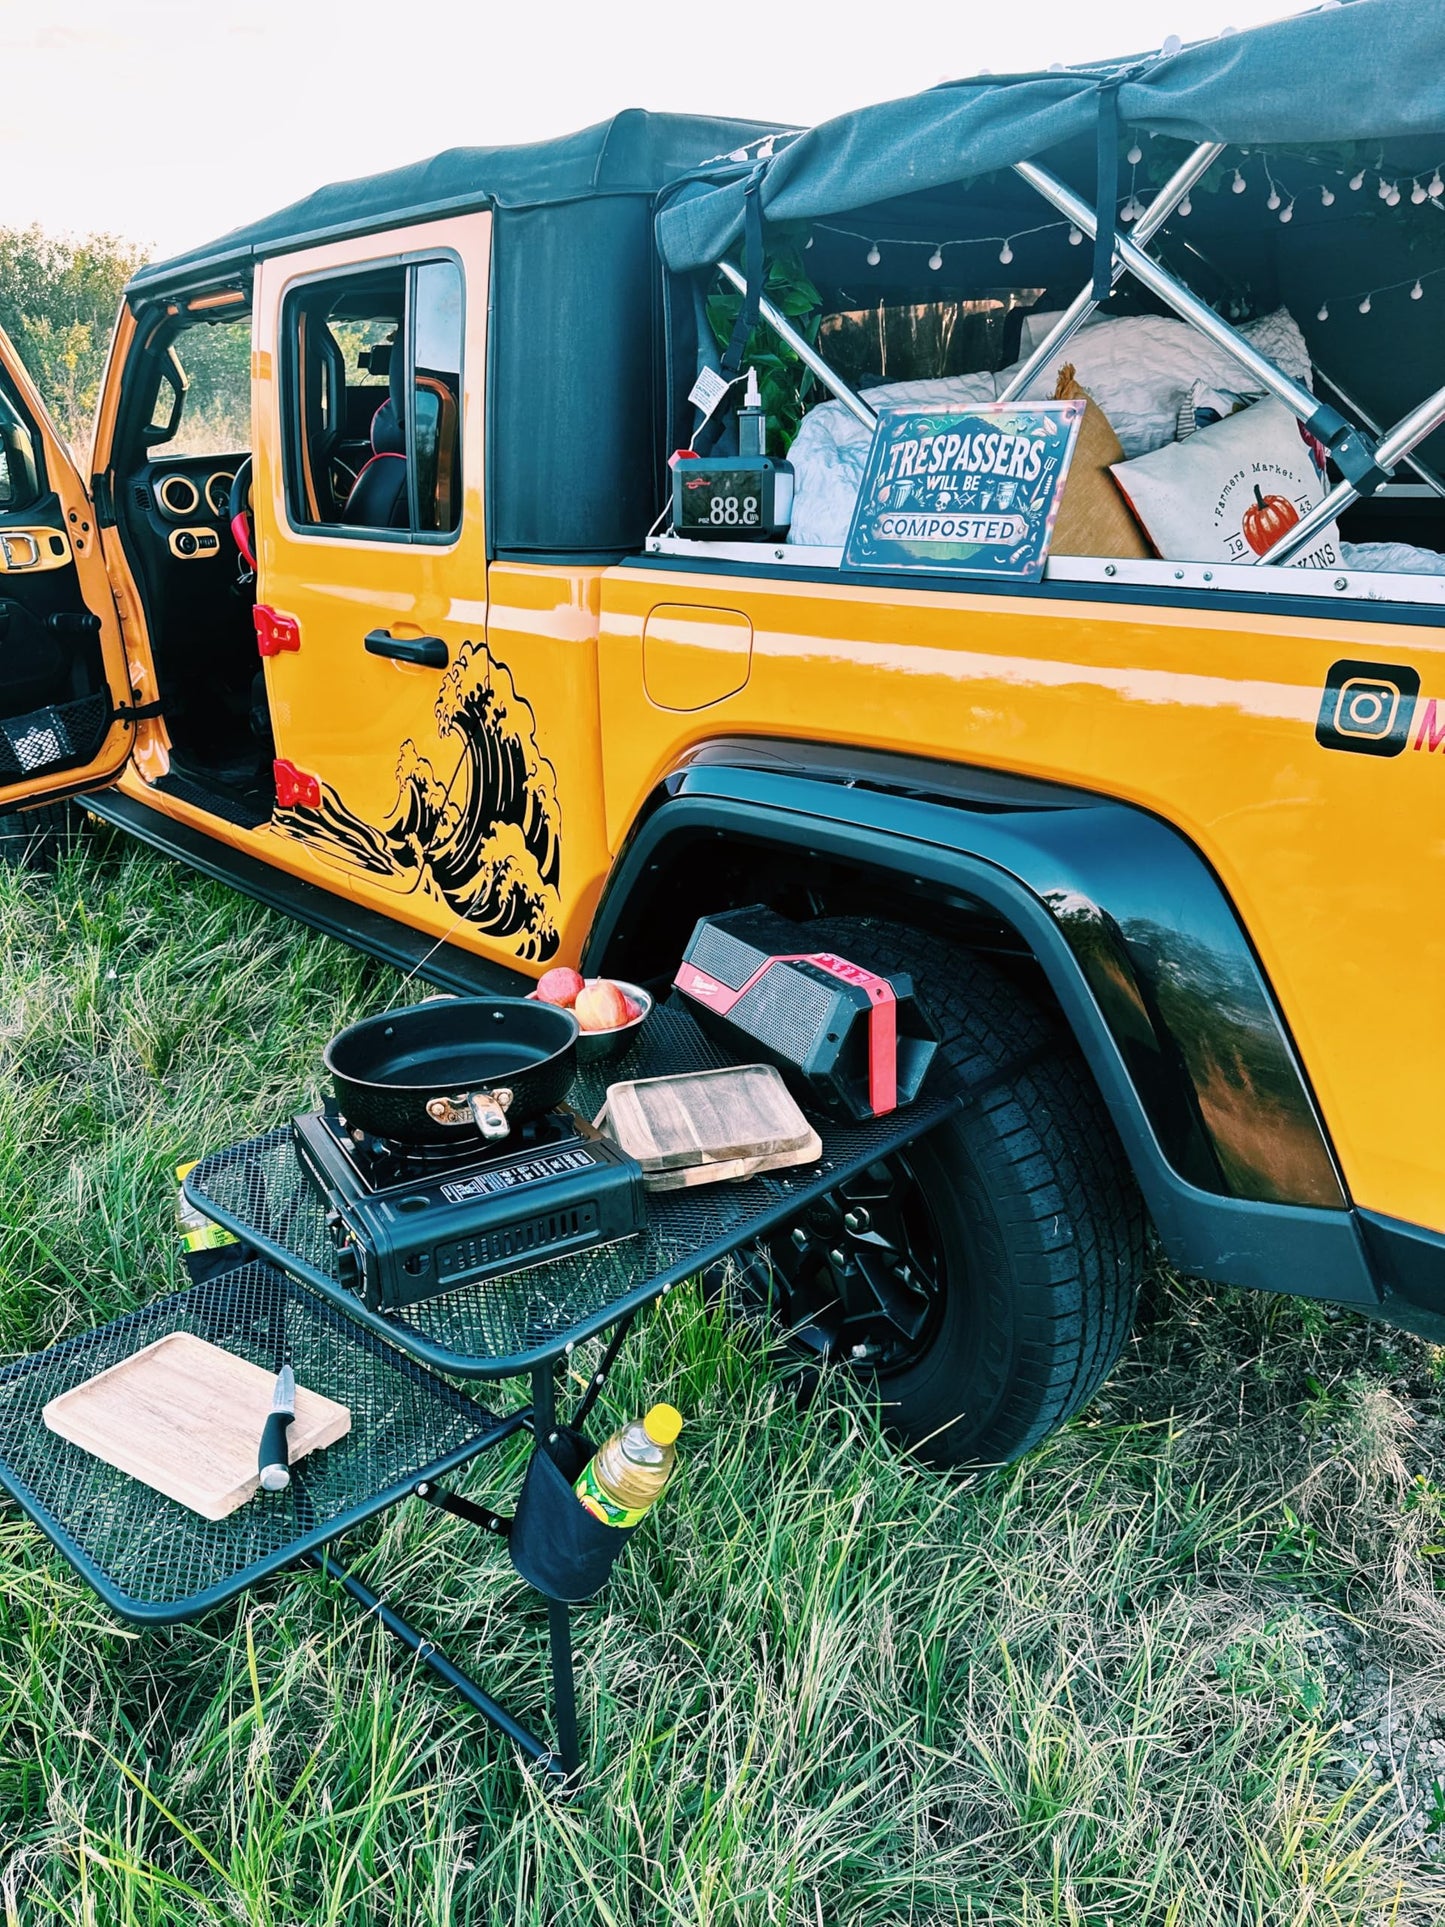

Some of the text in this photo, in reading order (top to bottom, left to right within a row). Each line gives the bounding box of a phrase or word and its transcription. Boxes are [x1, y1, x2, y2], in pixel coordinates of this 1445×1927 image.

[886, 433, 1046, 482] TRESPASSERS
[926, 475, 981, 491] WILL BE
[1215, 462, 1293, 517] Farmers Market
[710, 496, 758, 525] 88.8
[1299, 500, 1312, 514] 43
[881, 518, 1015, 539] COMPOSTED
[1229, 539, 1243, 555] 19
[1291, 543, 1336, 568] INS
